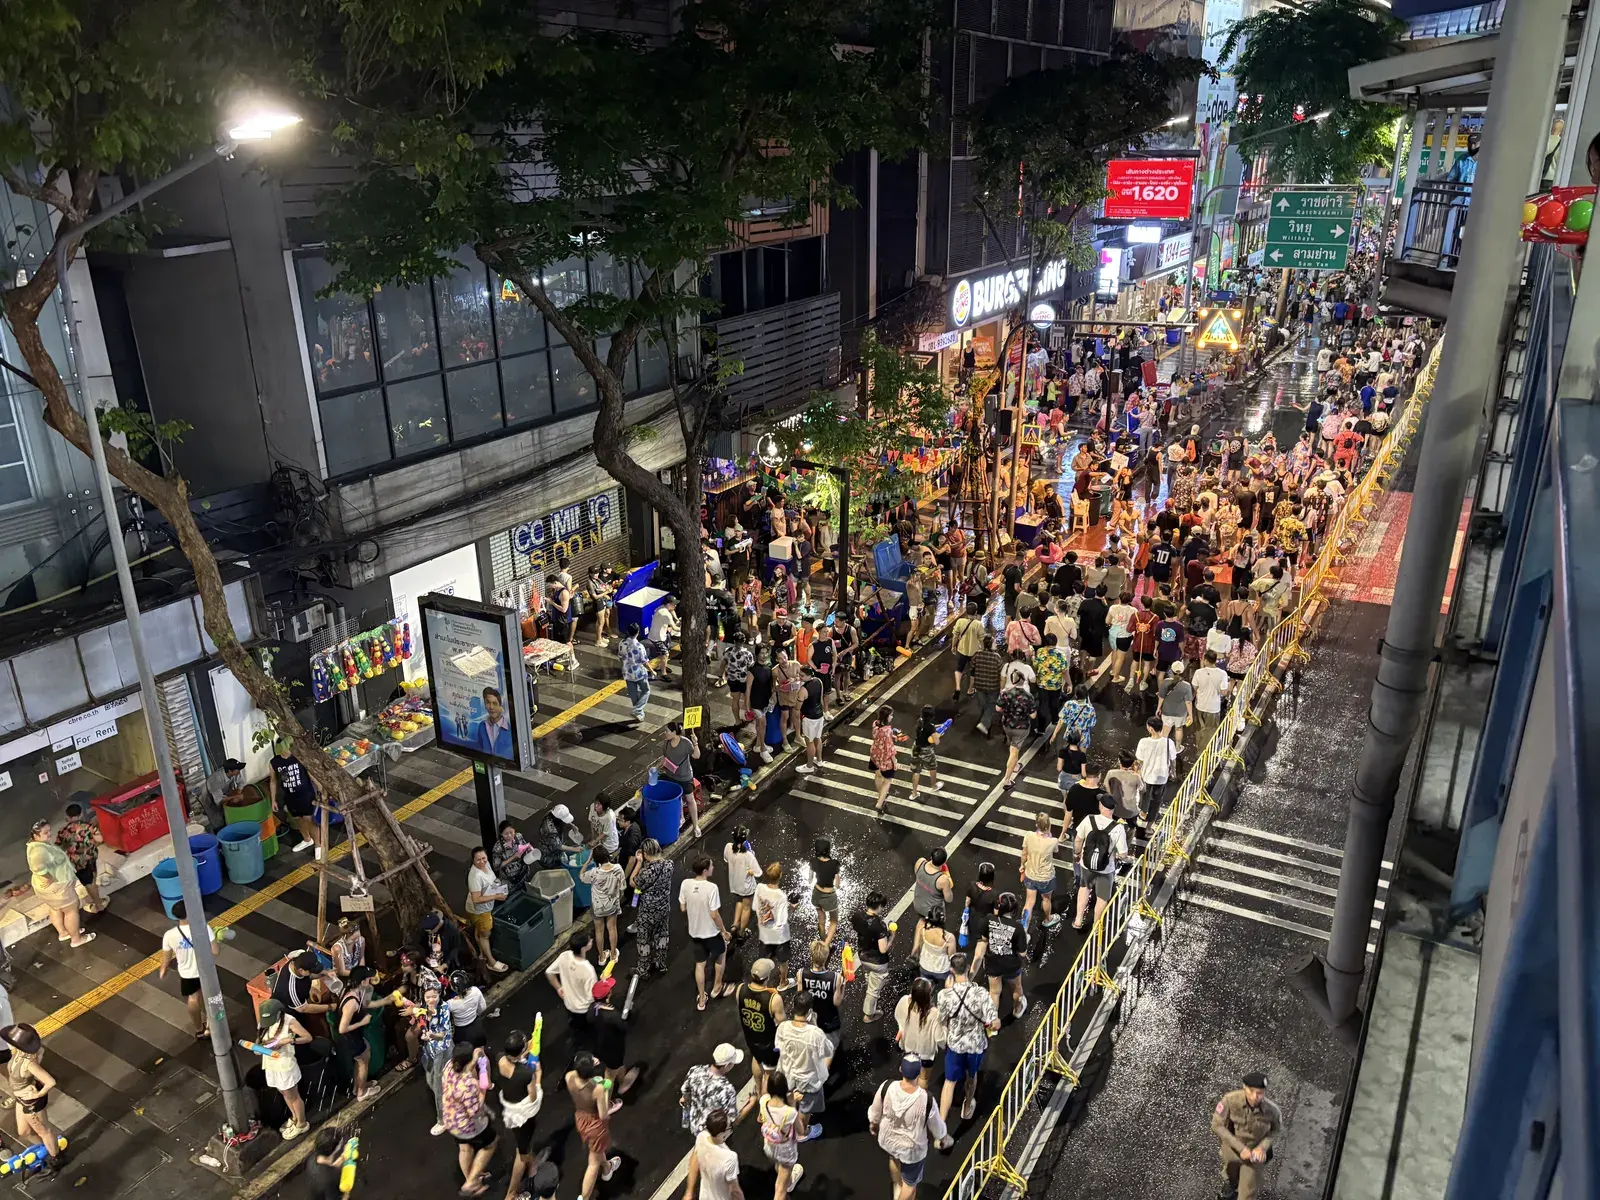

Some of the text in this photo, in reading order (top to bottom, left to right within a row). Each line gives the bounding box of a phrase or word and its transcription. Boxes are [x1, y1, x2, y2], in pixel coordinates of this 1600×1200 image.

[1133, 186, 1179, 201] 1,620
[1301, 195, 1344, 208] ราชดำริ
[1288, 220, 1312, 236] วิทยุ
[1293, 248, 1336, 260] สามย่าน
[1156, 550, 1170, 564] 10
[68, 710, 99, 725] cbre.co.th
[76, 725, 116, 746] For Rent
[804, 978, 831, 992] TEAM
[741, 1008, 766, 1033] 33
